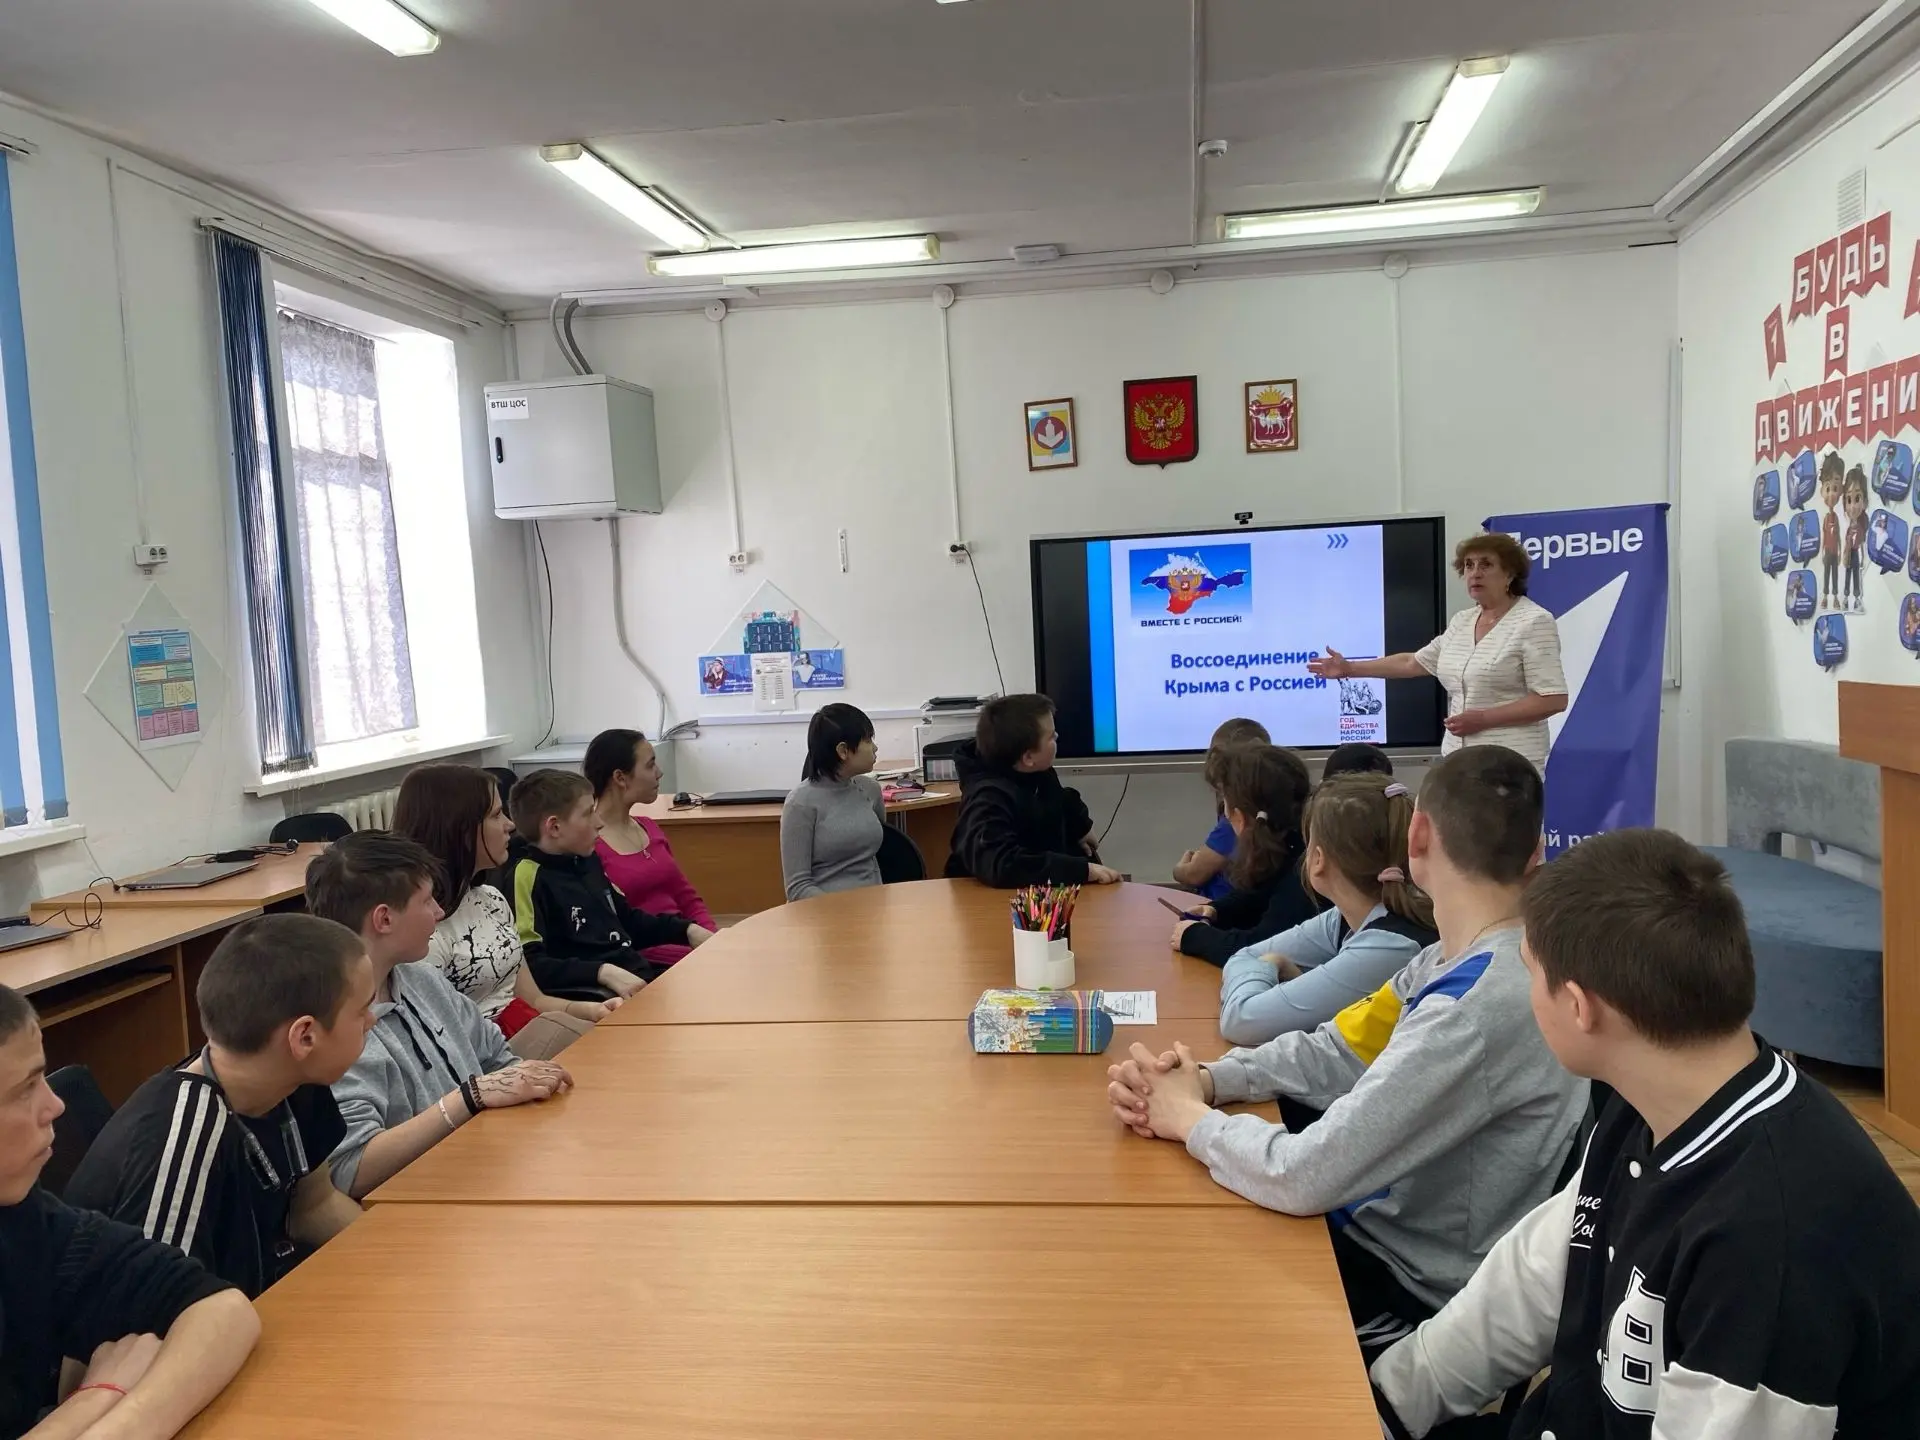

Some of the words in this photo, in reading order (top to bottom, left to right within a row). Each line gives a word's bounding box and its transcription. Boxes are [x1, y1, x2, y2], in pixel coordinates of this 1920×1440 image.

[1795, 235, 1886, 303] БУДЬ
[1829, 322, 1845, 361] В
[510, 400, 526, 408] ЦОС
[1756, 371, 1918, 452] ДВИЖЕНИ
[1141, 619, 1181, 627] ВМЕСТЕ
[1194, 615, 1242, 625] РОССИЕЙ!
[1171, 651, 1319, 669] Воссоединение
[1165, 679, 1230, 697] Крыма
[1235, 680, 1245, 692] с
[1250, 676, 1327, 692] Россией
